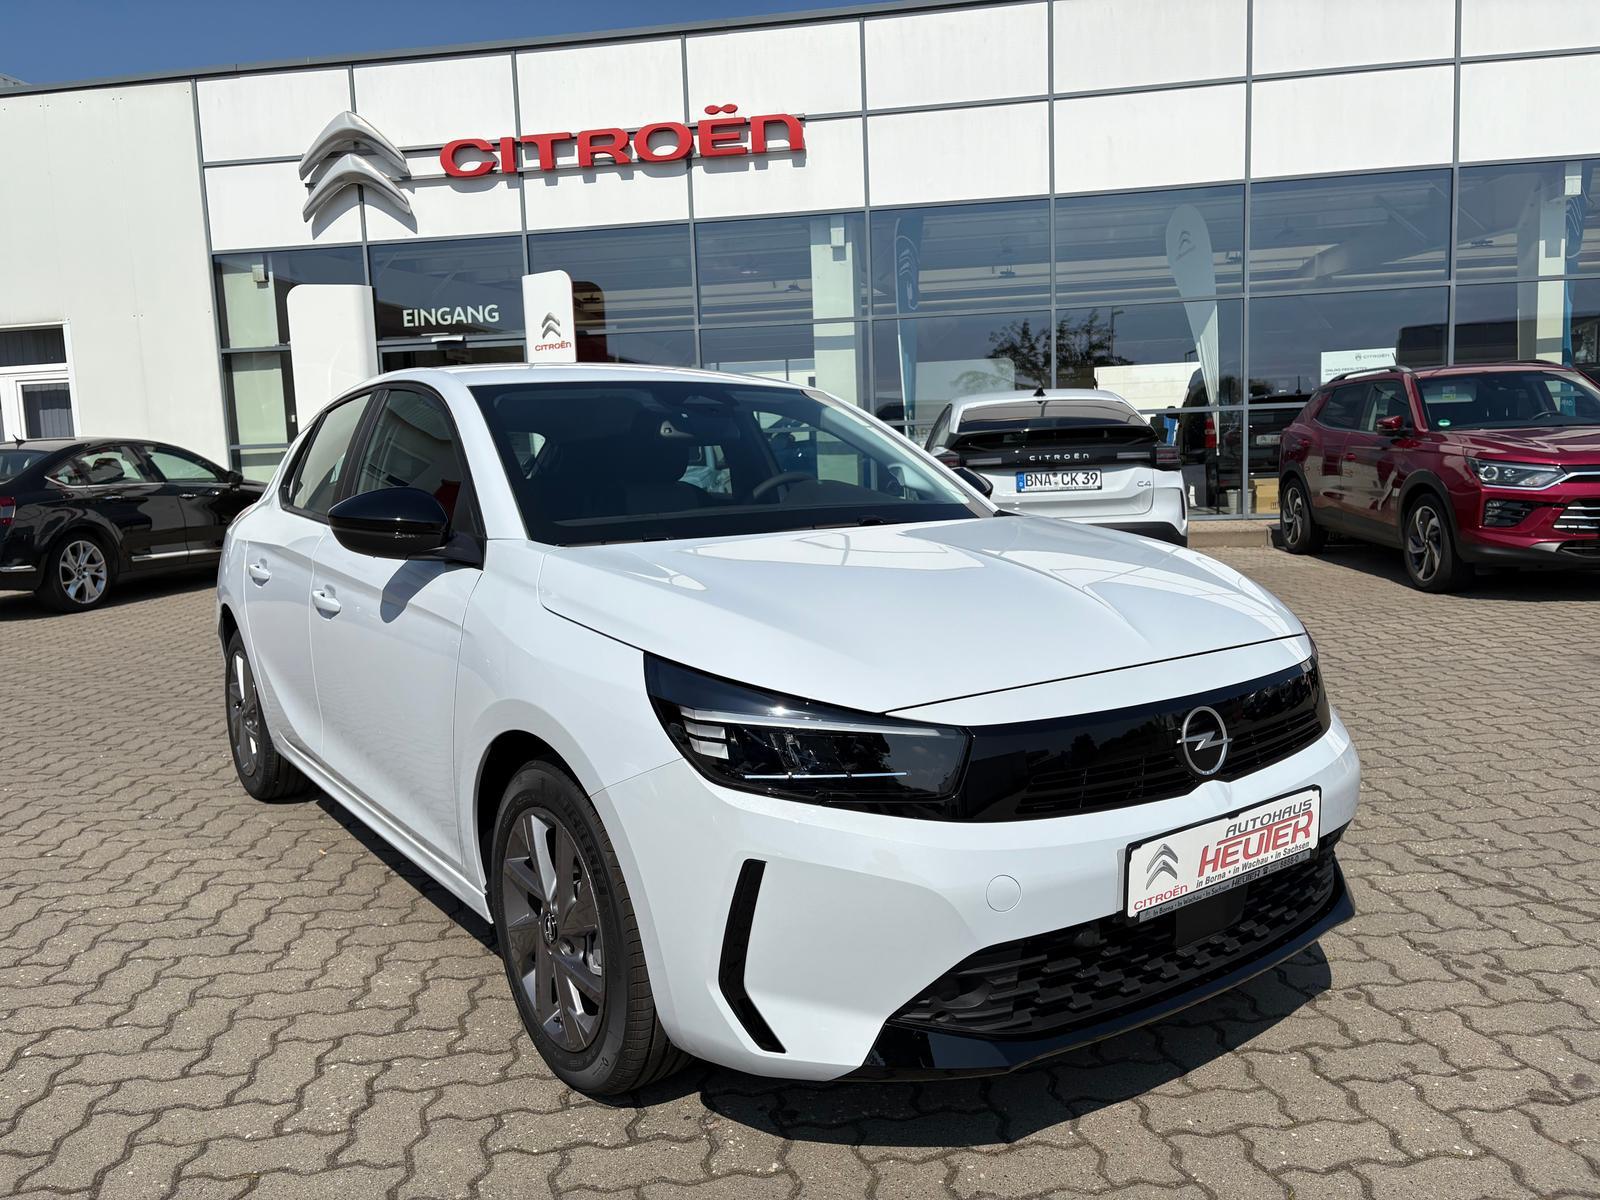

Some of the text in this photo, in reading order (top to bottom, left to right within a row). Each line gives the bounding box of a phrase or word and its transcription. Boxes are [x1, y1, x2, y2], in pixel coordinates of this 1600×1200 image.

[440, 103, 804, 178] CITROËN
[402, 304, 500, 328] EINGANG
[534, 340, 573, 352] CITROËN
[1029, 452, 1090, 461] CITROËN
[1025, 471, 1098, 487] BNA CK 39
[1136, 480, 1152, 488] C4
[1226, 798, 1313, 838] AUTOHAUS
[1197, 810, 1314, 878] HEUTER
[1195, 879, 1204, 889] in
[1205, 871, 1226, 885] Borna
[1232, 865, 1240, 875] in
[1241, 855, 1269, 872] Wachau
[1274, 850, 1282, 860] in
[1282, 842, 1310, 857] Sachsen
[1133, 884, 1188, 911] CITROËN
